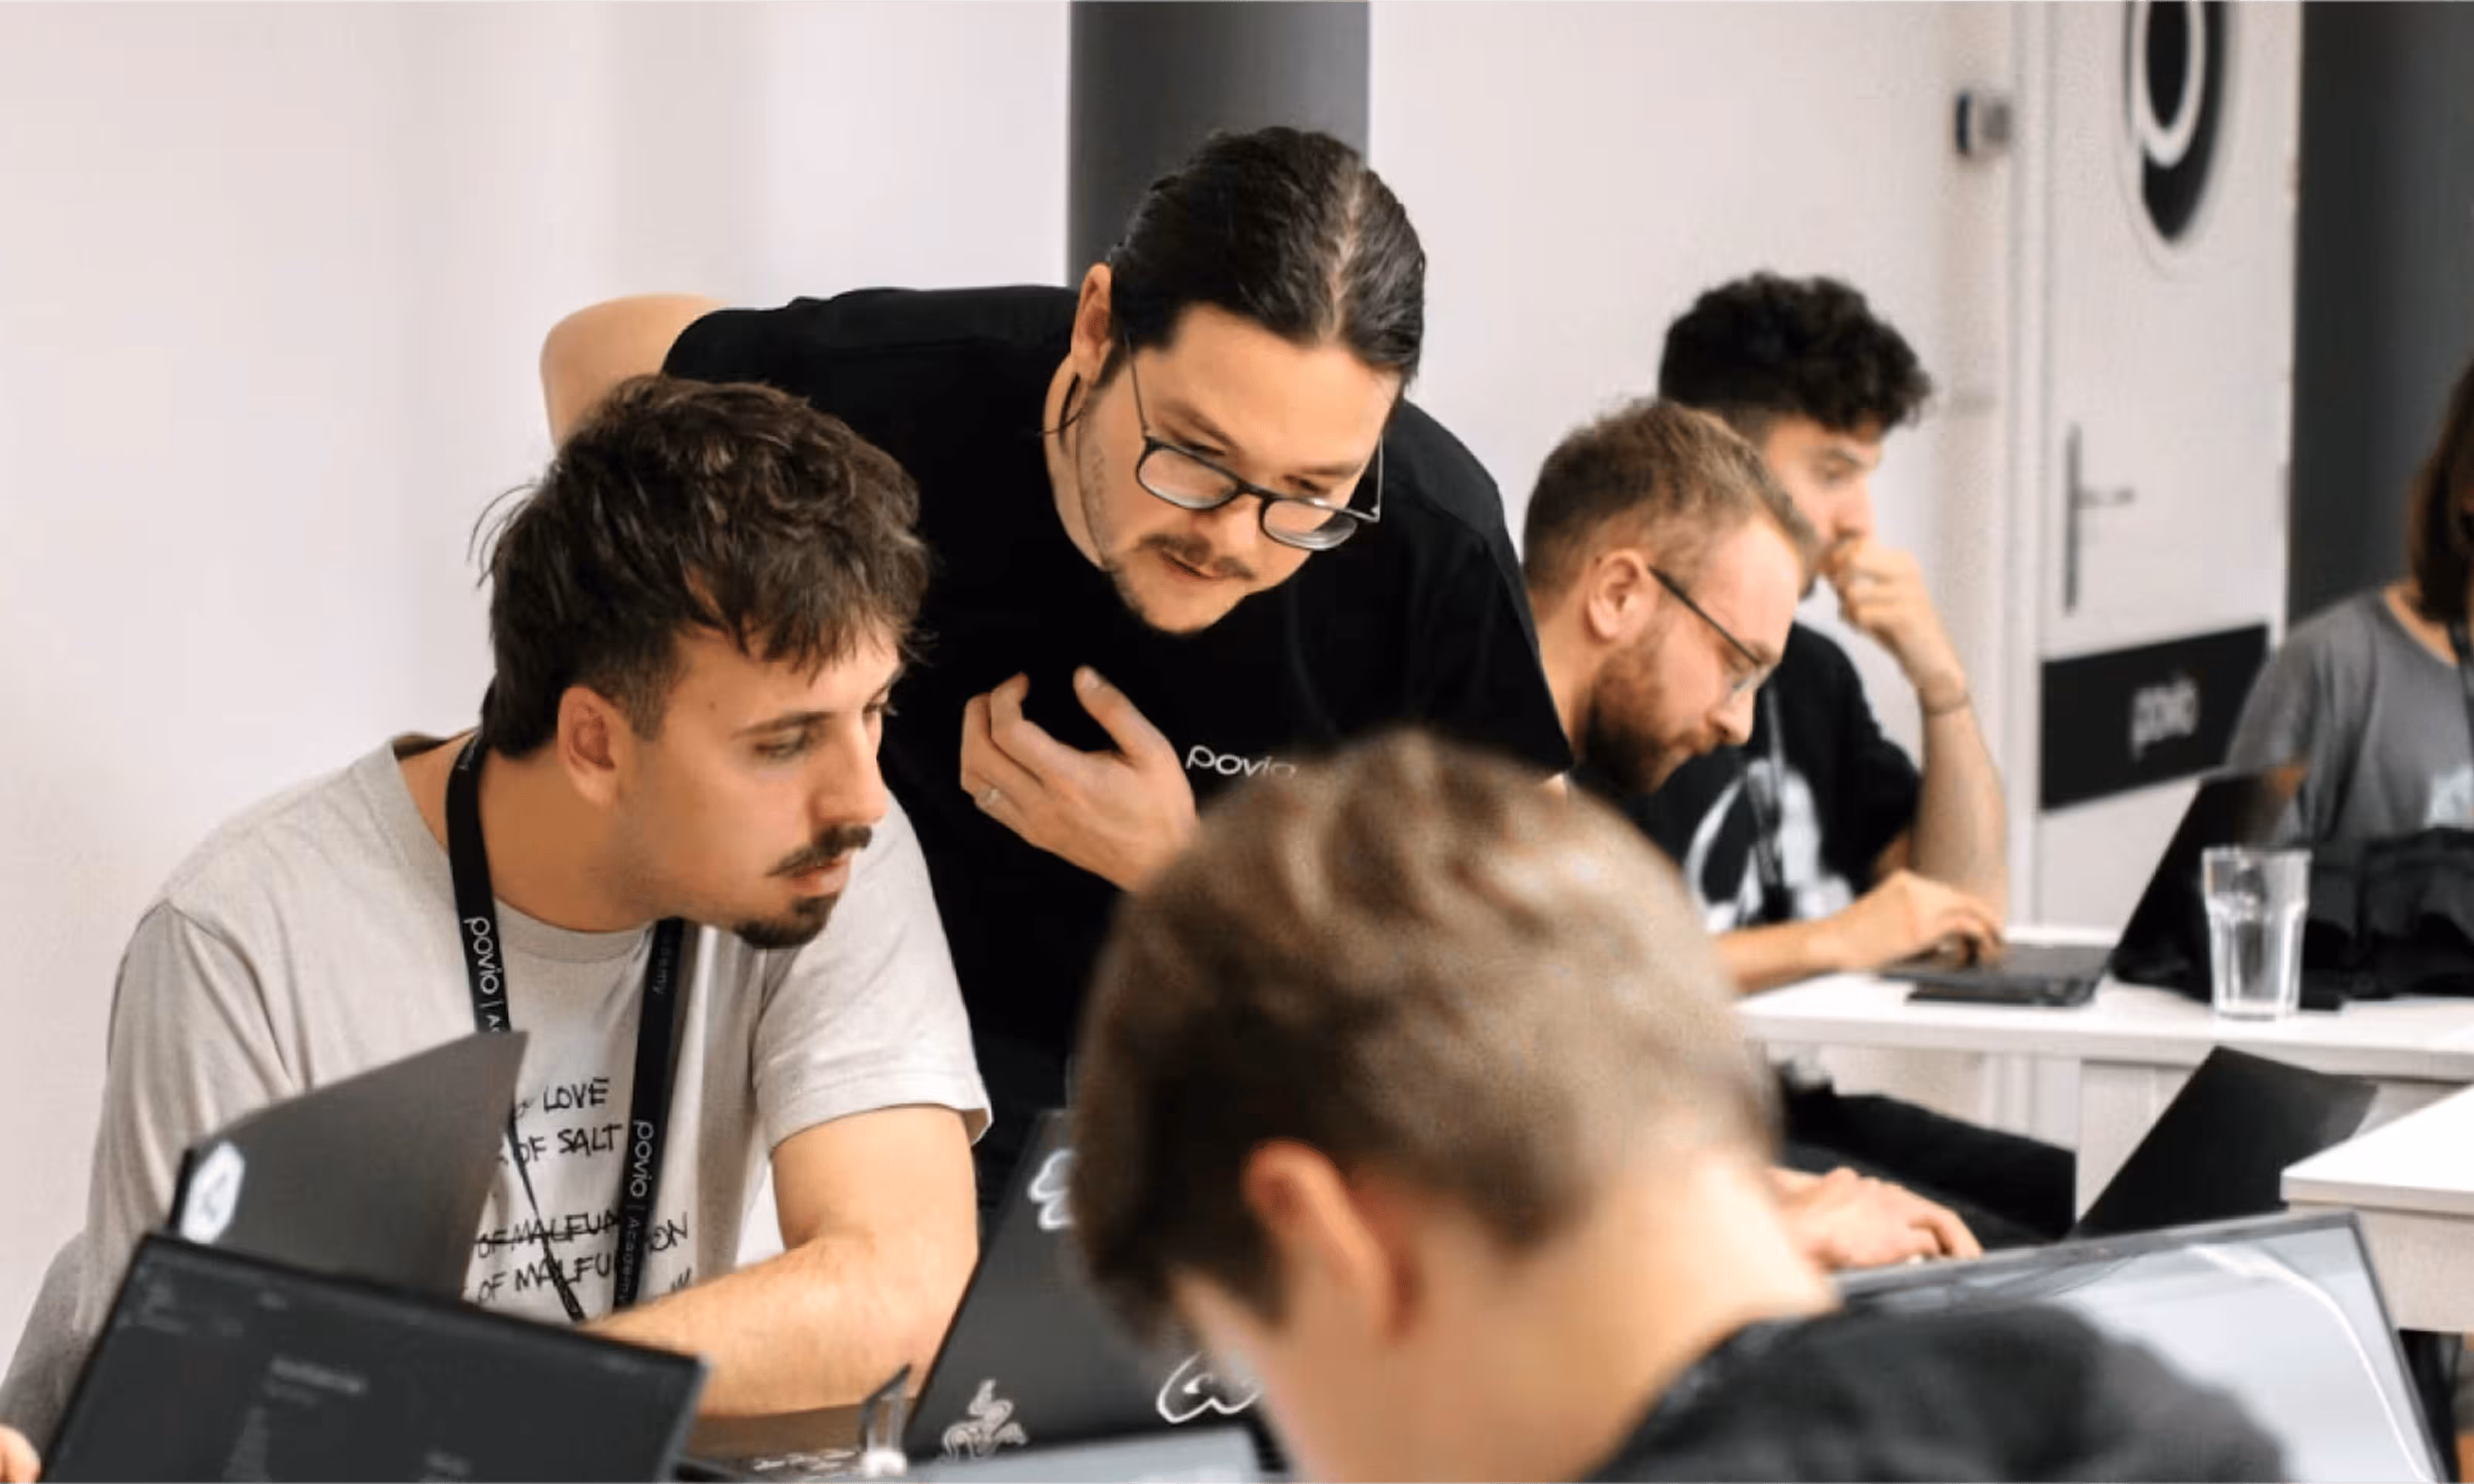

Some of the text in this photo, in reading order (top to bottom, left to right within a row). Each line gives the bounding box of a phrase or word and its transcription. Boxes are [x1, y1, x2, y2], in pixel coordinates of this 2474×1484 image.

[464, 917, 503, 995] povio
[544, 1077, 609, 1113] LOVE
[557, 1124, 622, 1157] SALT
[630, 1120, 655, 1198] povio
